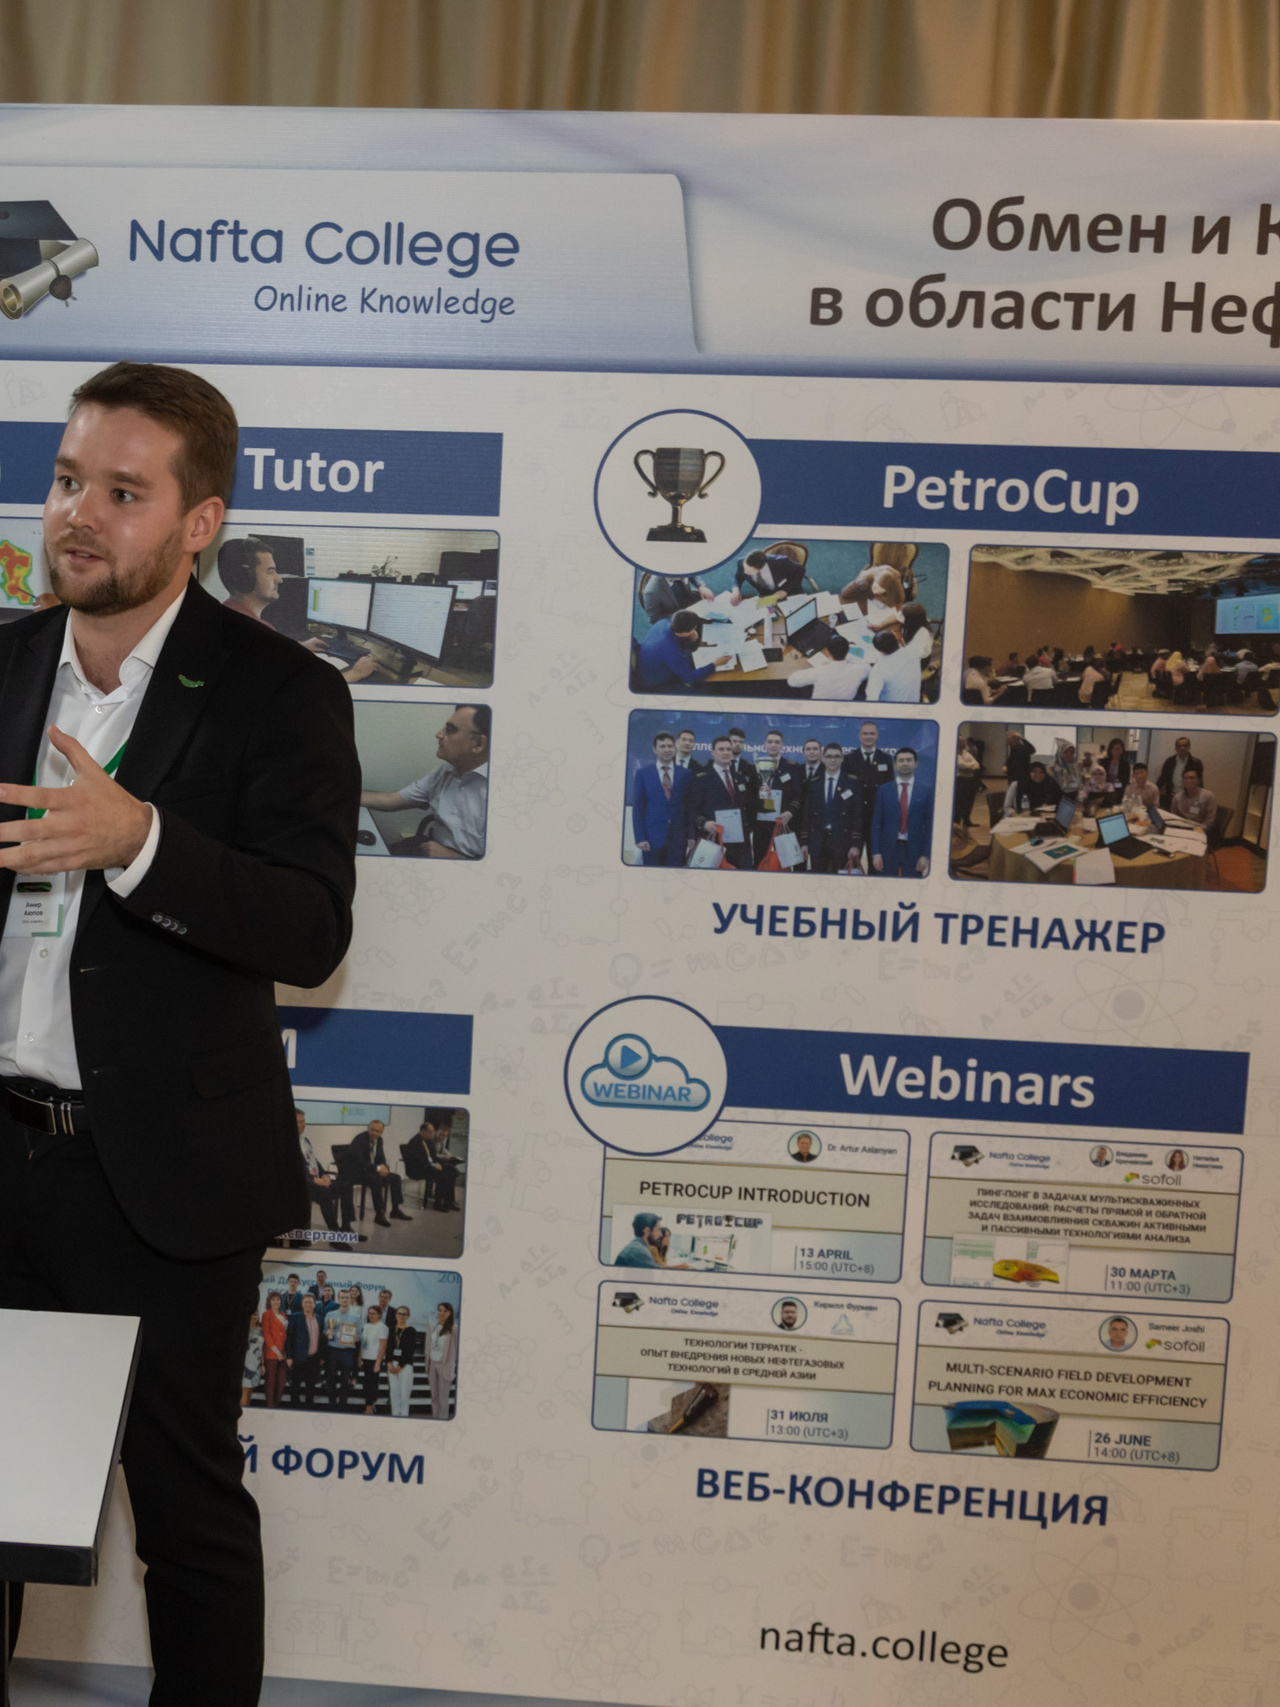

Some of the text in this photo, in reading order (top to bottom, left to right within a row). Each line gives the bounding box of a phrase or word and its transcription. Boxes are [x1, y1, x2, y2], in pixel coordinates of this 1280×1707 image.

[932, 195, 1231, 255] Обмен и
[129, 219, 520, 279] Nafta College
[254, 285, 516, 323] Online Knowledge
[810, 287, 843, 326] в
[865, 273, 1136, 332] области
[244, 448, 385, 493] Tutor
[883, 464, 1139, 526] PetroCup
[713, 900, 1166, 954] УЧЕБНЫЙ ТРЕНАЖЕР
[840, 1053, 1094, 1108] Webinars
[593, 1082, 691, 1102] WEBINAR
[989, 1152, 1051, 1162] Nafta College
[640, 1181, 870, 1207] PETROCUP INTRODUCTION
[977, 1188, 1200, 1208] ПИНГ-ПОНГ ЗАДАЧАХ МУЛЬТИСКВАЖИННЫХ
[969, 1200, 1206, 1221] ИССЛЕДОВАНИЙ: РАСЧЕТЫ ПРЯМОЙ ОБРАТНОЙ
[968, 1211, 1207, 1233] ЗАДАЧ ВЗАИМОВЛИЯНИЯ СКВАЖИН АКТИВНЫМИ
[991, 1225, 1191, 1244] ПАССИВНЫМИ ТЕХНОЛОГИЯМИ АНАЛИЗА
[800, 1248, 853, 1260] 13 APRIL
[800, 1261, 828, 1271] 15:00
[1110, 1266, 1176, 1281] 30 МАРТА
[1110, 1280, 1190, 1297] 11:00 (UTC+3)
[649, 1296, 719, 1310] Nafta College
[814, 1301, 844, 1309] Кирилл
[973, 1316, 1047, 1331] Nafta College
[684, 1338, 797, 1353] ТЕХНОЛОГИИ ТЕРРАТЕК
[640, 1348, 845, 1370] ОПЫТ ВНЕДРЕНИЯ НОВЫХ НЕФТЕГАЗОВЫХ
[668, 1362, 816, 1381] ТЕХНОЛОГИЙ СРЕДНЕЙ АЗИИ
[946, 1362, 1192, 1388] MULTI-SCENARIO FIELD DEVELOPMENT
[928, 1380, 1207, 1408] PLANNING FOR MAX ECONOMIC EFFICIENCY
[770, 1409, 828, 1423] 31 ИЮЛЯ
[770, 1424, 849, 1441] 13:00 (UTC+3)
[1095, 1433, 1151, 1447] 26 JUNE
[1094, 1447, 1127, 1458] 14:00
[272, 1445, 424, 1485] ФОРУМ
[696, 1468, 1109, 1530] ВЕБ-КОНФЕРЕНЦИЯ
[759, 1622, 1009, 1674] nafta.college
